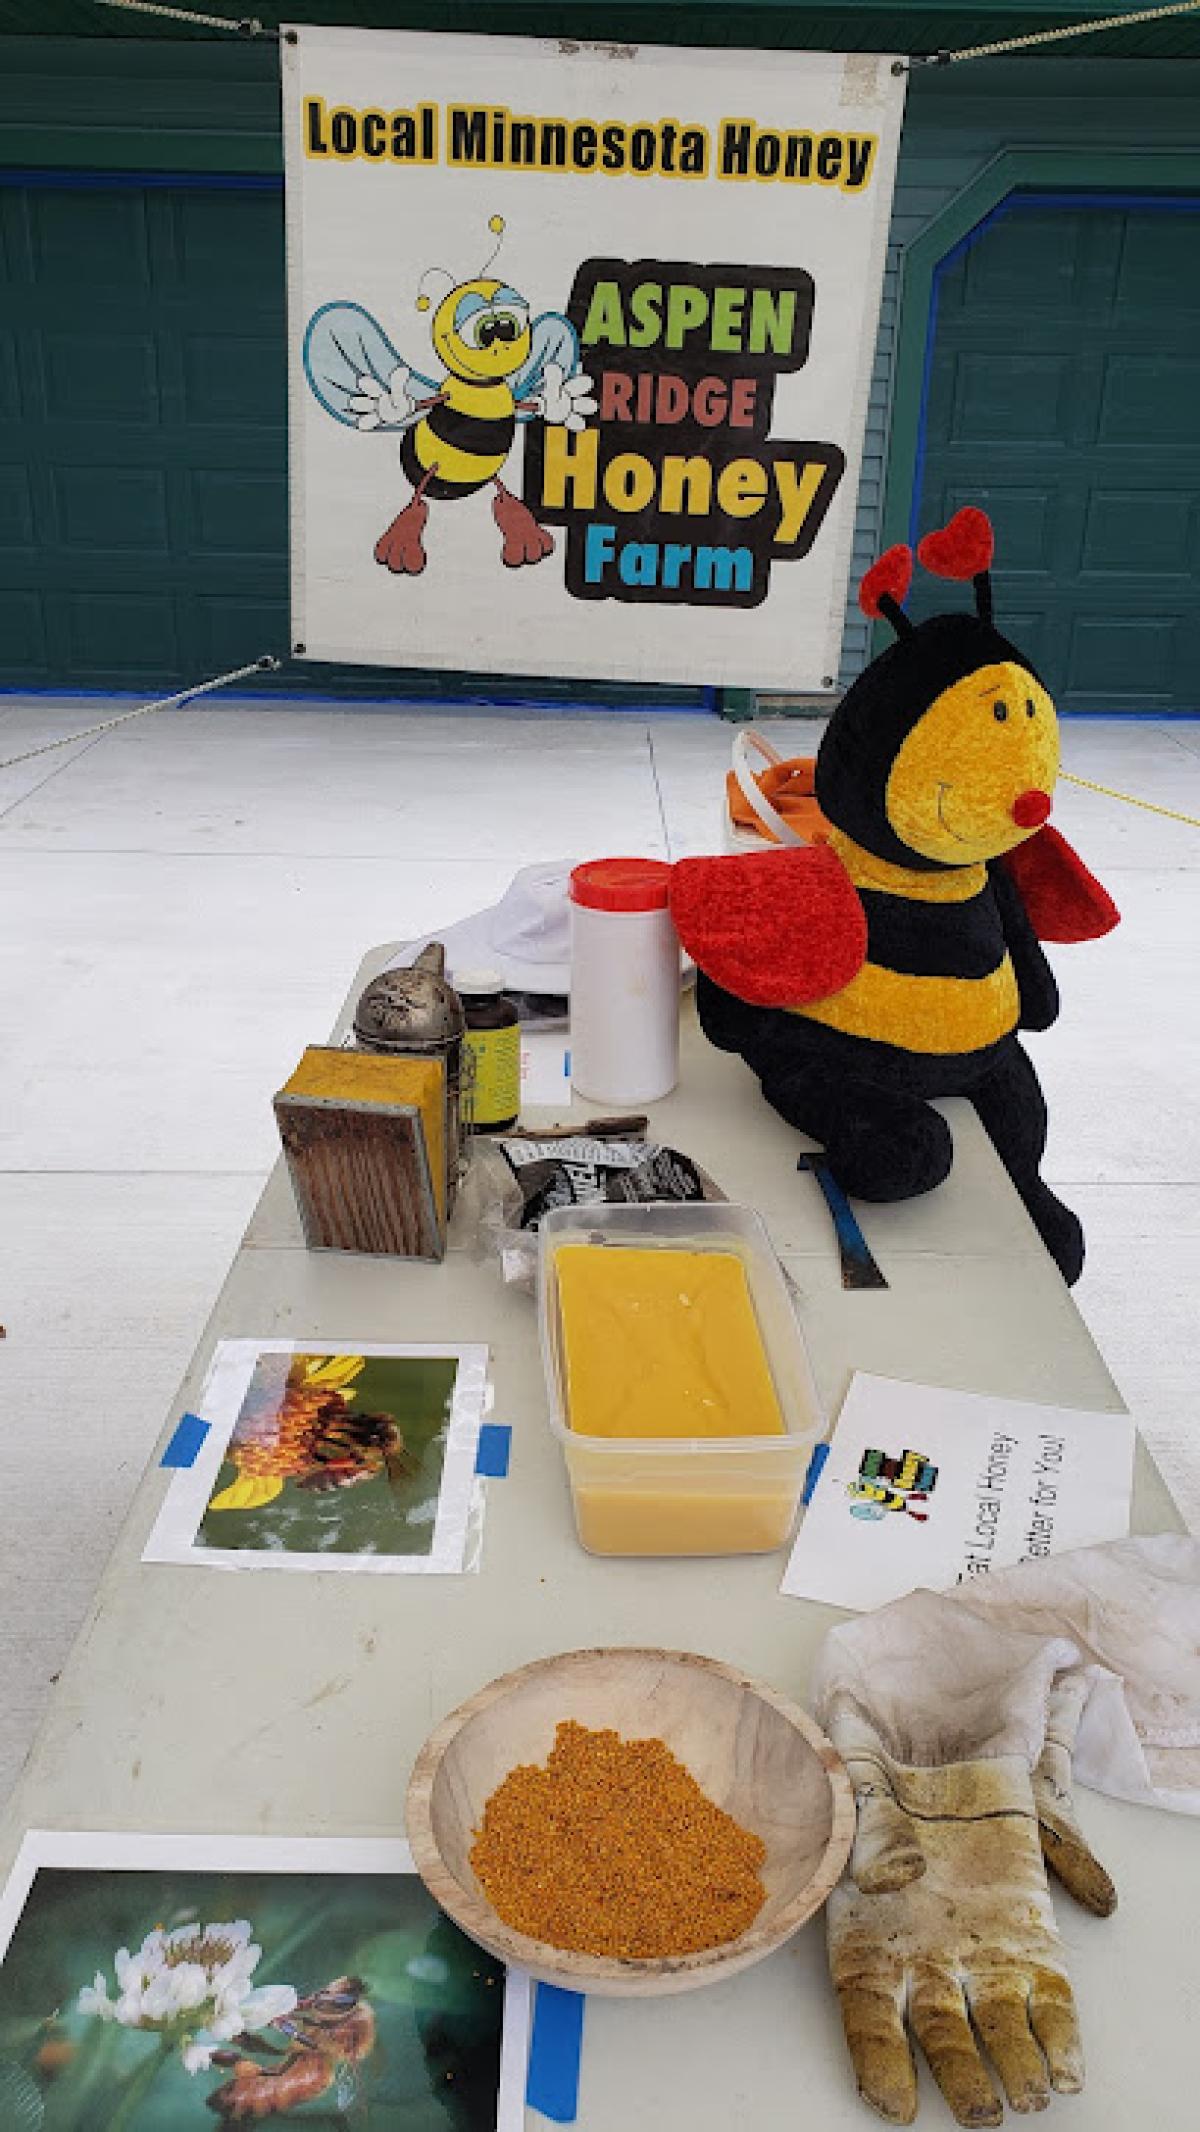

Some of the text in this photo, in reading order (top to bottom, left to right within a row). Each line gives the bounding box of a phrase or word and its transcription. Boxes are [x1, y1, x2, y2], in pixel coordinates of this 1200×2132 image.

[306, 102, 873, 187] Local Minnesota Honey
[581, 281, 797, 355] ASPEN
[601, 372, 757, 428] RIDGE
[541, 426, 828, 543] Honey
[583, 523, 753, 592] Farm
[976, 1431, 1019, 1492] Honey
[1028, 1478, 1058, 1507] for
[965, 1493, 1001, 1550] Local
